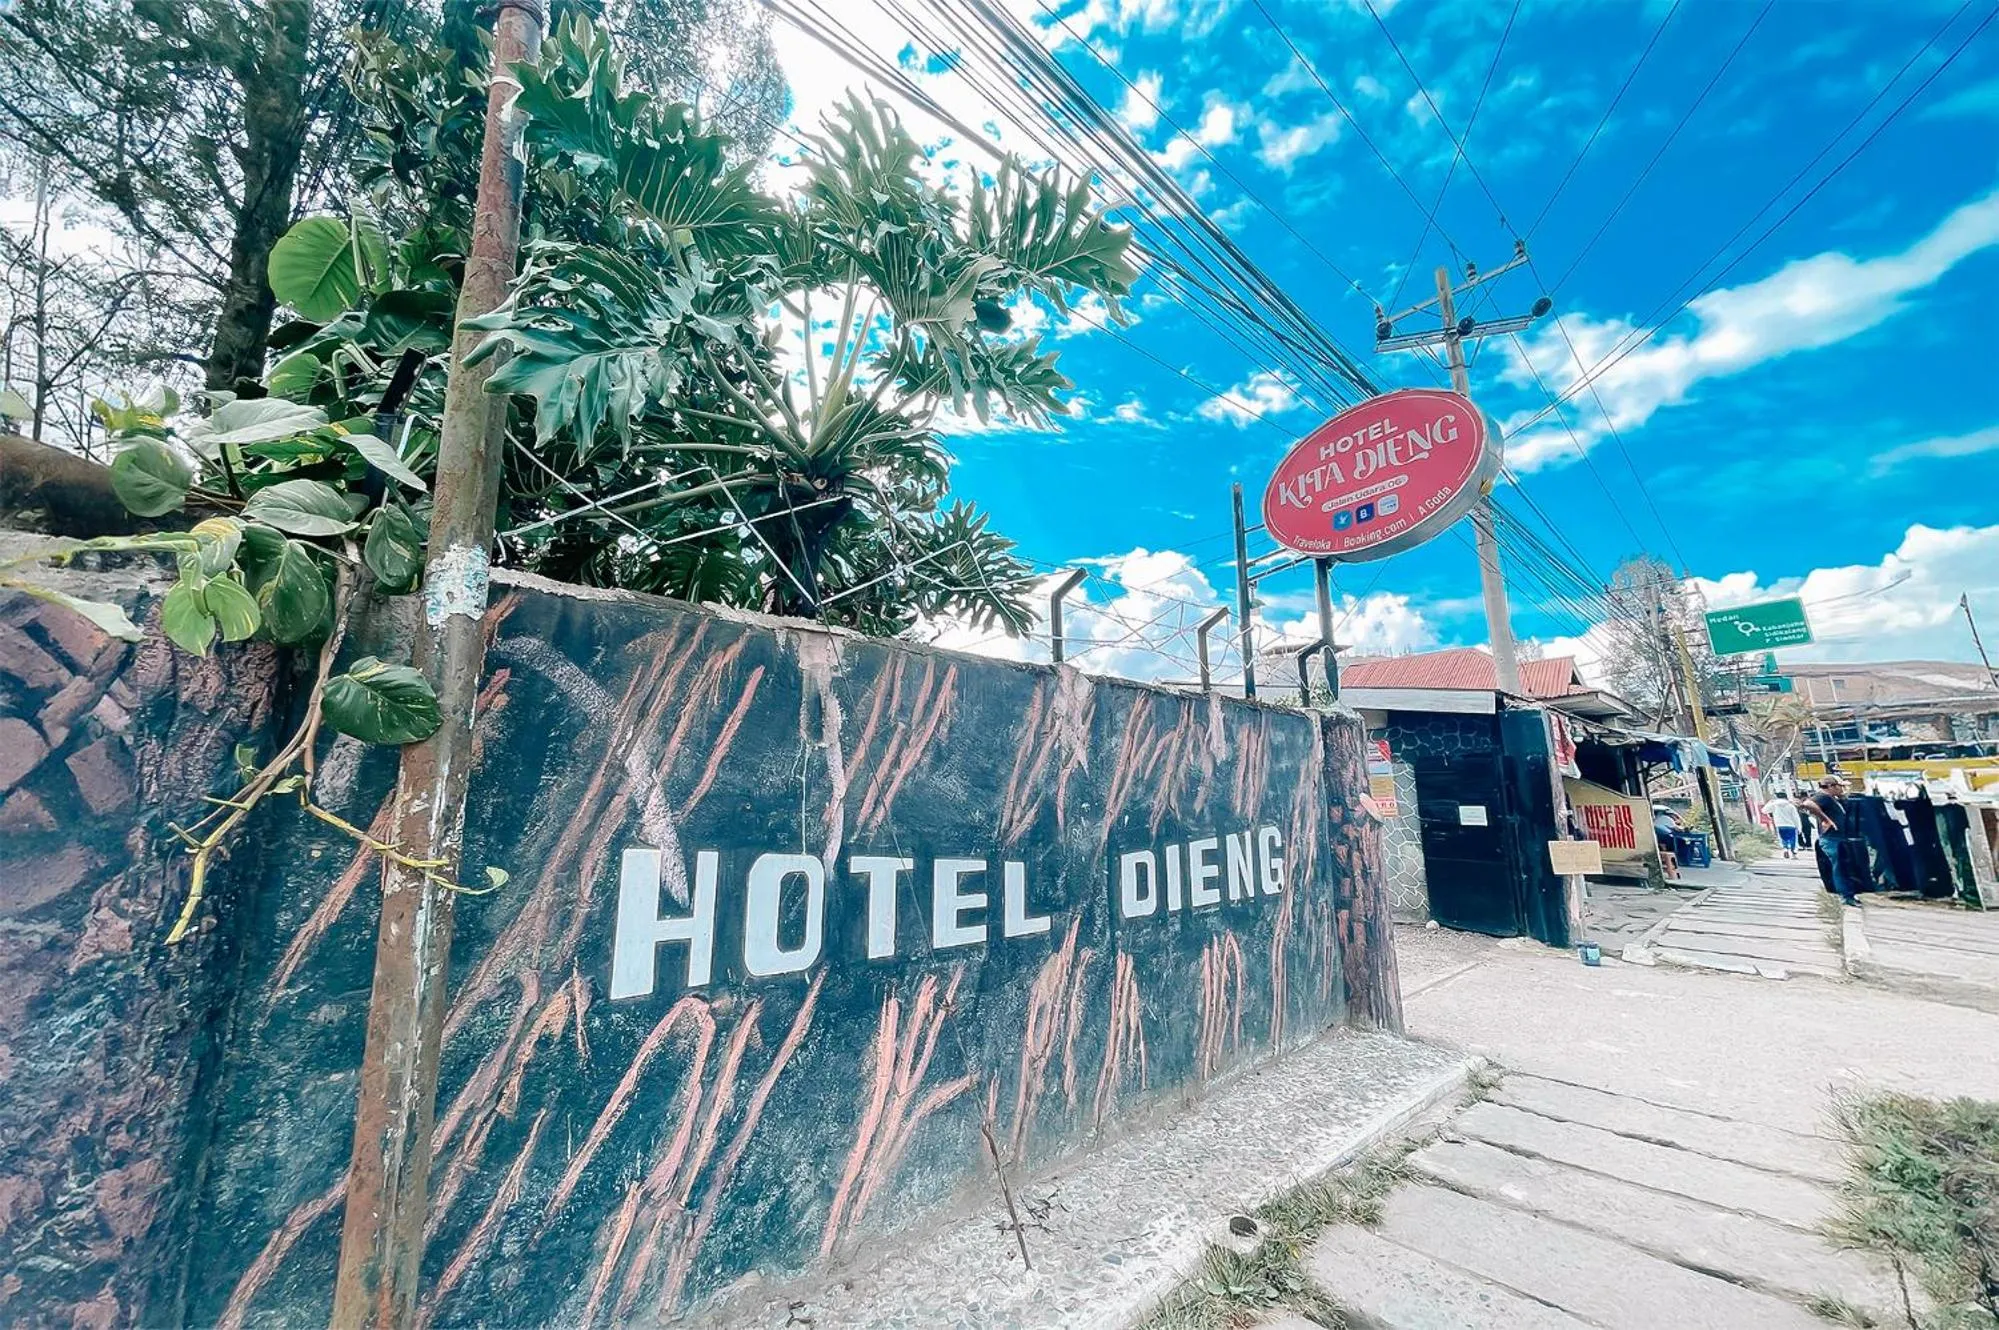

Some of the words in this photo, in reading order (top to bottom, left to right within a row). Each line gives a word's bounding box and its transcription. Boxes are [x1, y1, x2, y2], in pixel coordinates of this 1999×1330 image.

[1320, 418, 1398, 461] HOTEL
[1278, 461, 1345, 509] KITA
[1353, 415, 1458, 480] DIENG
[1328, 495, 1354, 509] Jalan
[1293, 535, 1331, 550] Traveloka
[1344, 518, 1407, 548] Booking.com
[610, 848, 1052, 1001] HOTEL
[1120, 826, 1285, 919] DIENG
